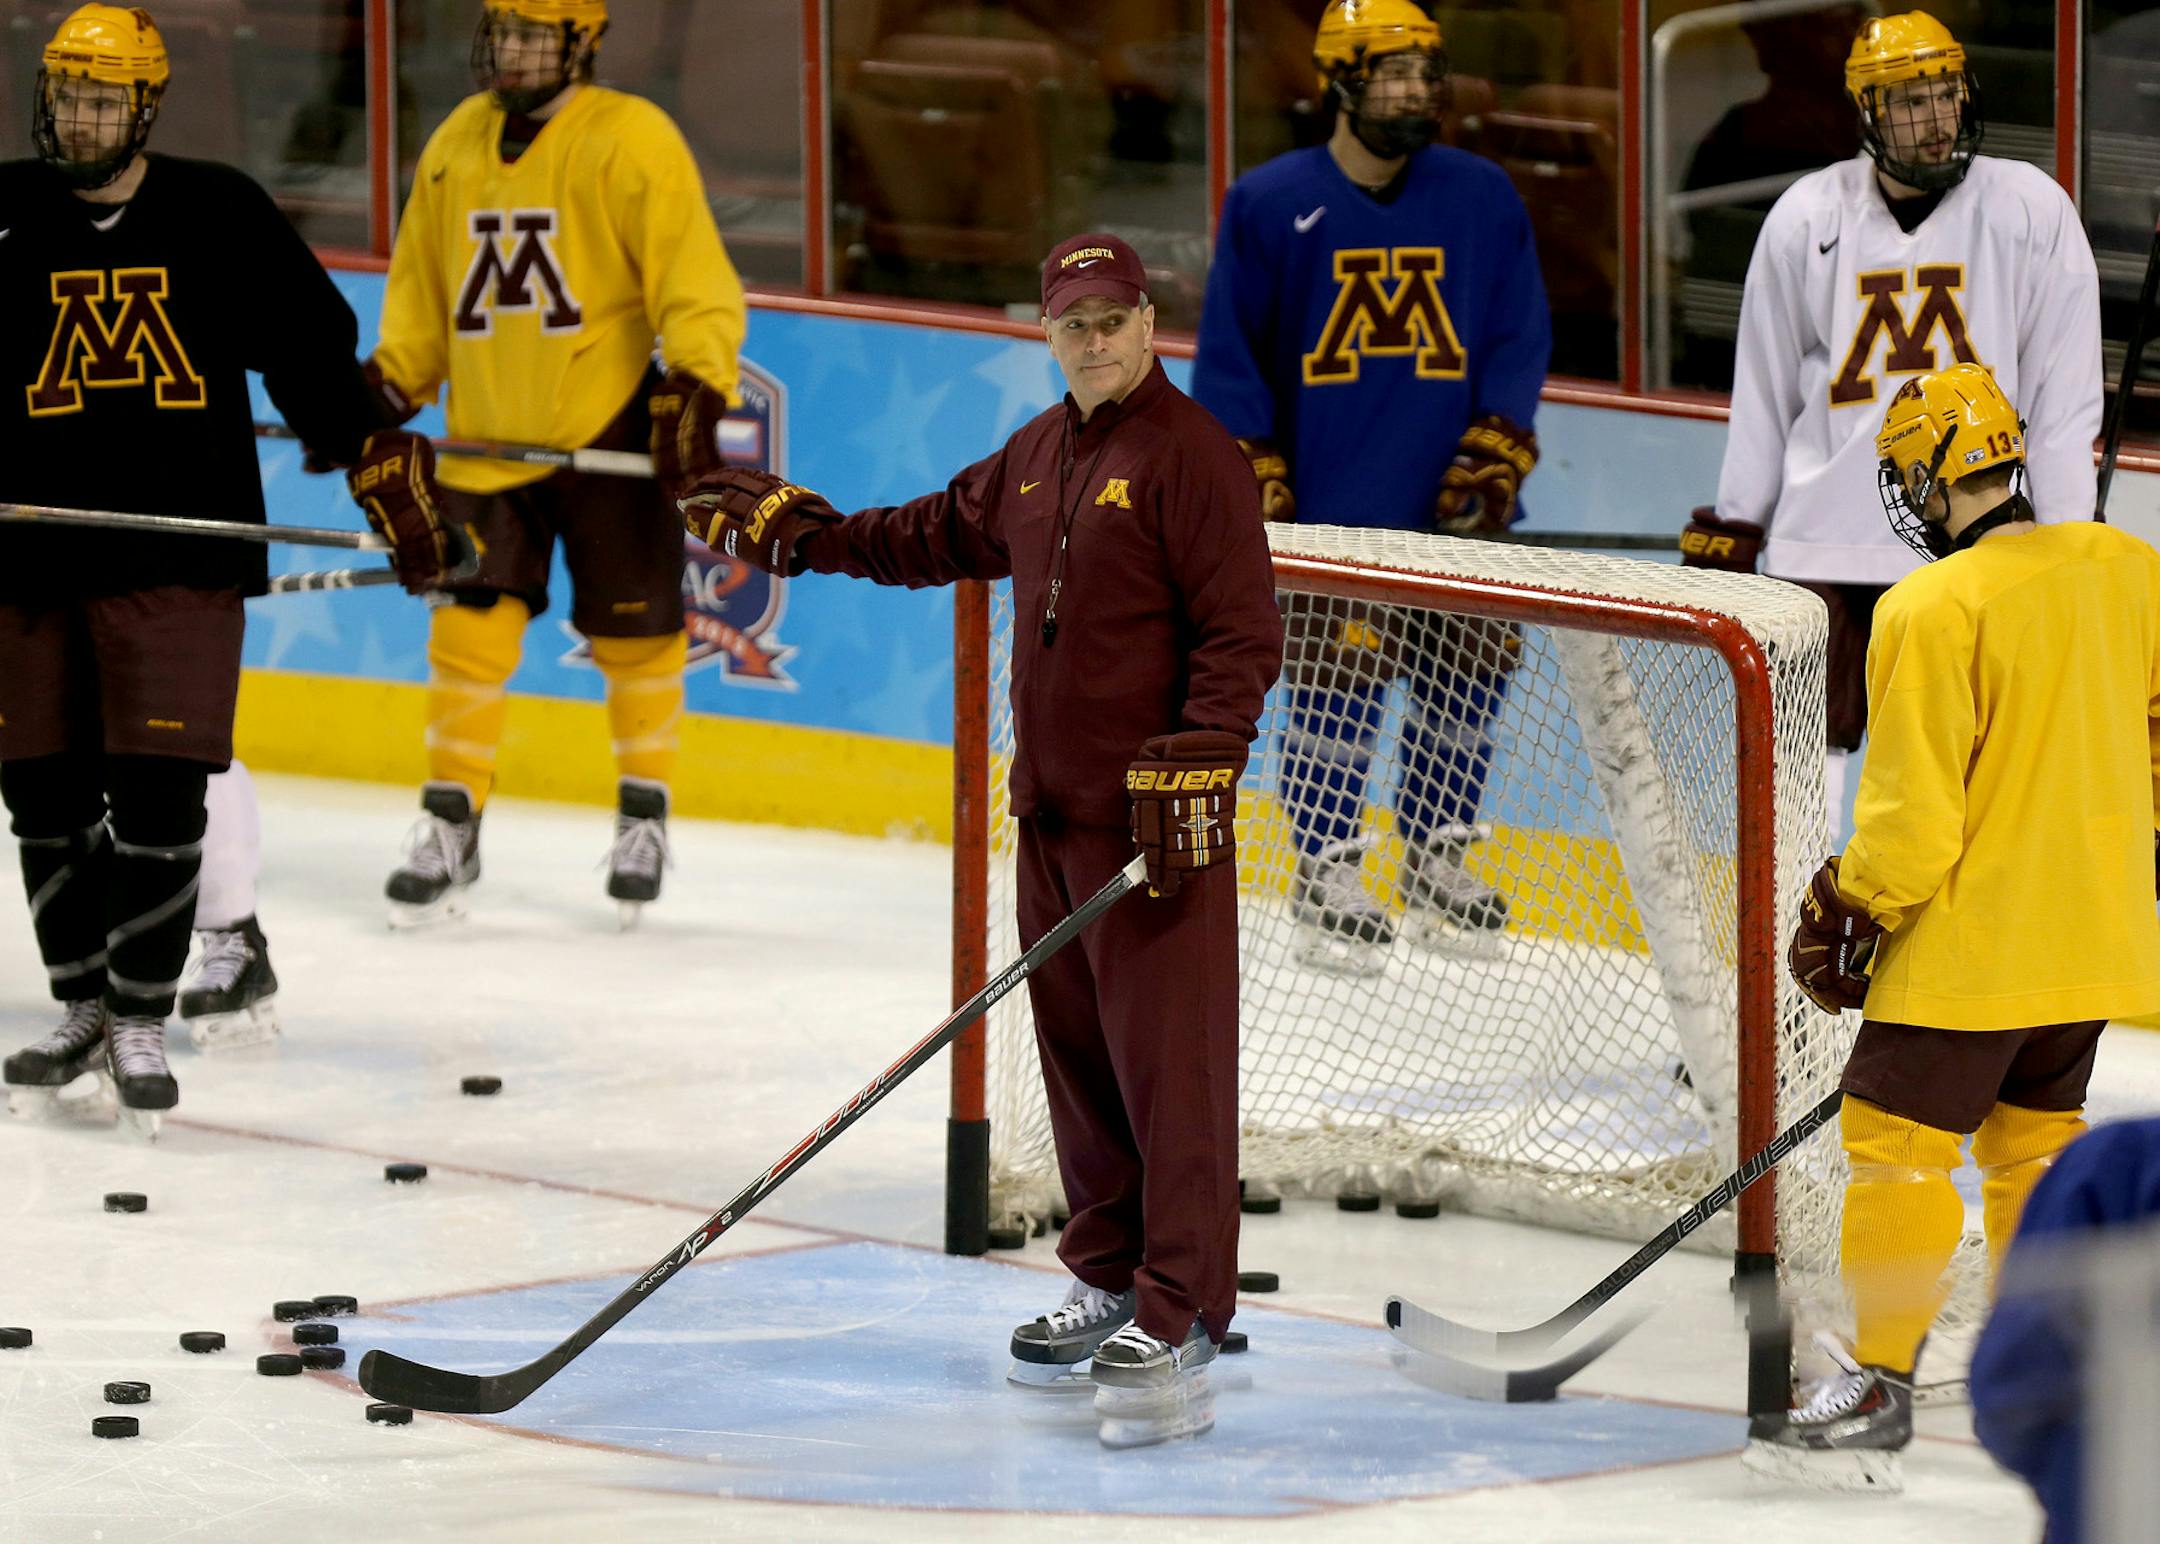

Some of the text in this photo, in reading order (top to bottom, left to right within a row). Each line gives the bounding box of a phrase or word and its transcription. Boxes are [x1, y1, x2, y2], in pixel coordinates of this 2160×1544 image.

[454, 208, 583, 337] M
[1060, 247, 1115, 268] MINNESOTA
[1302, 246, 1467, 386] M
[25, 266, 207, 417] M
[1829, 263, 1995, 409] M
[1890, 423, 1922, 443] BAUER
[1986, 431, 2012, 459] 13
[1095, 477, 1132, 509] M
[1919, 478, 1931, 505] CCM
[745, 485, 808, 544] UER
[1126, 768, 1234, 792] BAUER
[985, 961, 1029, 1004] BAUER
[1674, 1106, 1823, 1240] BAUER
[635, 1260, 675, 1292] VAPOR
